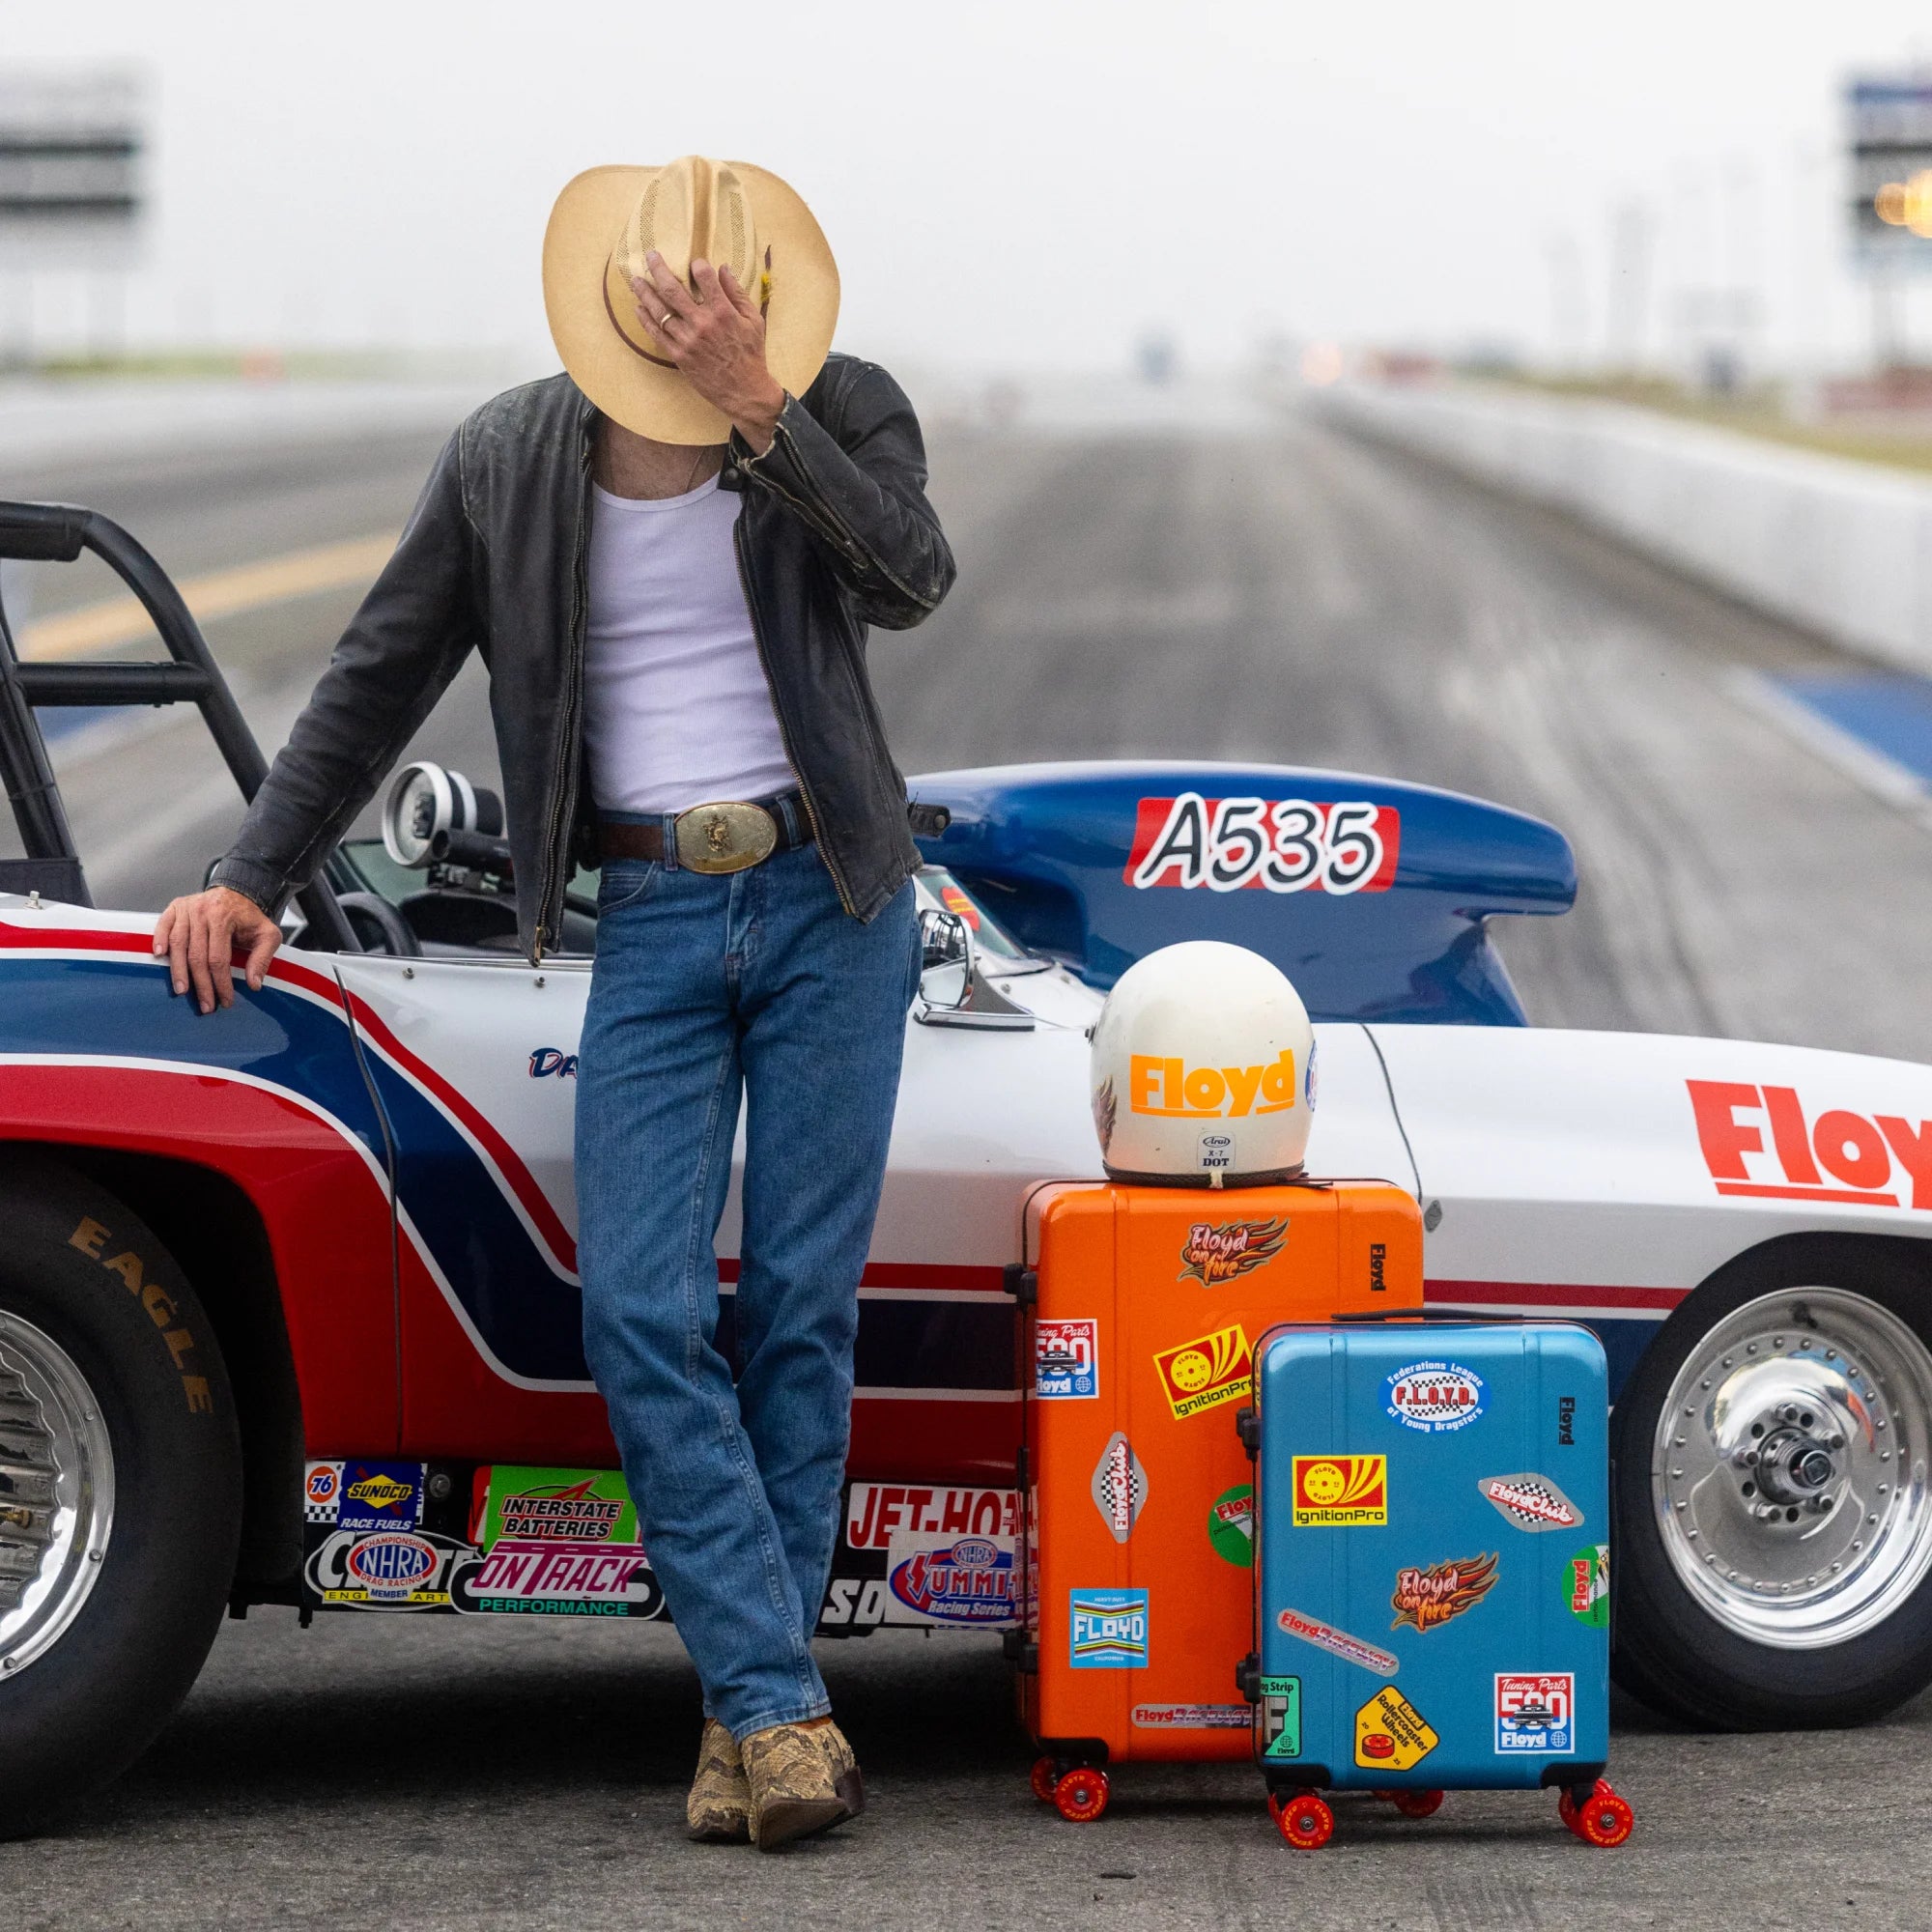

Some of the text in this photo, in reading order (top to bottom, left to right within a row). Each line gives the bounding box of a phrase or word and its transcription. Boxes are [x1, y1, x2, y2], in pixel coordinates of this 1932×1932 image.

[1134, 792, 1382, 895] A535
[1130, 1048, 1295, 1118] Floyd
[1685, 1079, 1932, 1211] Floy
[1203, 1157, 1230, 1167] DOT
[1191, 1226, 1248, 1258] Floyd
[1204, 1254, 1239, 1285] fire
[1371, 1243, 1386, 1292] Floyd
[68, 1215, 213, 1414] EAGLE
[1061, 1324, 1091, 1338] Parts
[1386, 1361, 1484, 1387] Federations League
[1396, 1386, 1476, 1406] F.L.O.Y.D.
[1386, 1406, 1484, 1433] of Young Dragsters
[1559, 1397, 1576, 1445] Floyd
[311, 1474, 334, 1495] 76
[349, 1484, 411, 1498] SUNOCO
[1109, 1440, 1129, 1532] FloydClub
[502, 1498, 619, 1519] INTERSTATE
[1215, 1496, 1253, 1521] Floy
[1489, 1481, 1575, 1524] FloydClub
[340, 1518, 412, 1530] RACE FUELS
[503, 1518, 611, 1537] BATTERIES
[1296, 1510, 1384, 1524] IgnitionPro
[363, 1536, 426, 1551] CHAMPIONSHIP
[958, 1546, 991, 1564] NHRA
[362, 1546, 424, 1578] NHRA
[360, 1574, 423, 1586] DRAG RACING
[1401, 1569, 1459, 1603] Floyd
[1573, 1560, 1590, 1611] Floyd
[370, 1589, 410, 1599] MEMBER
[479, 1599, 629, 1615] PERFORMANCE
[927, 1600, 1010, 1616] Racing Series
[1417, 1599, 1452, 1631] fire
[1074, 1615, 1144, 1642] FLOYD
[1270, 1682, 1294, 1693] Strip
[1501, 1679, 1568, 1692] Tuning Parts
[1378, 1694, 1428, 1751] Rollercoaster
[1381, 1713, 1409, 1747] Wheels
[1501, 1731, 1547, 1747] Floyd
